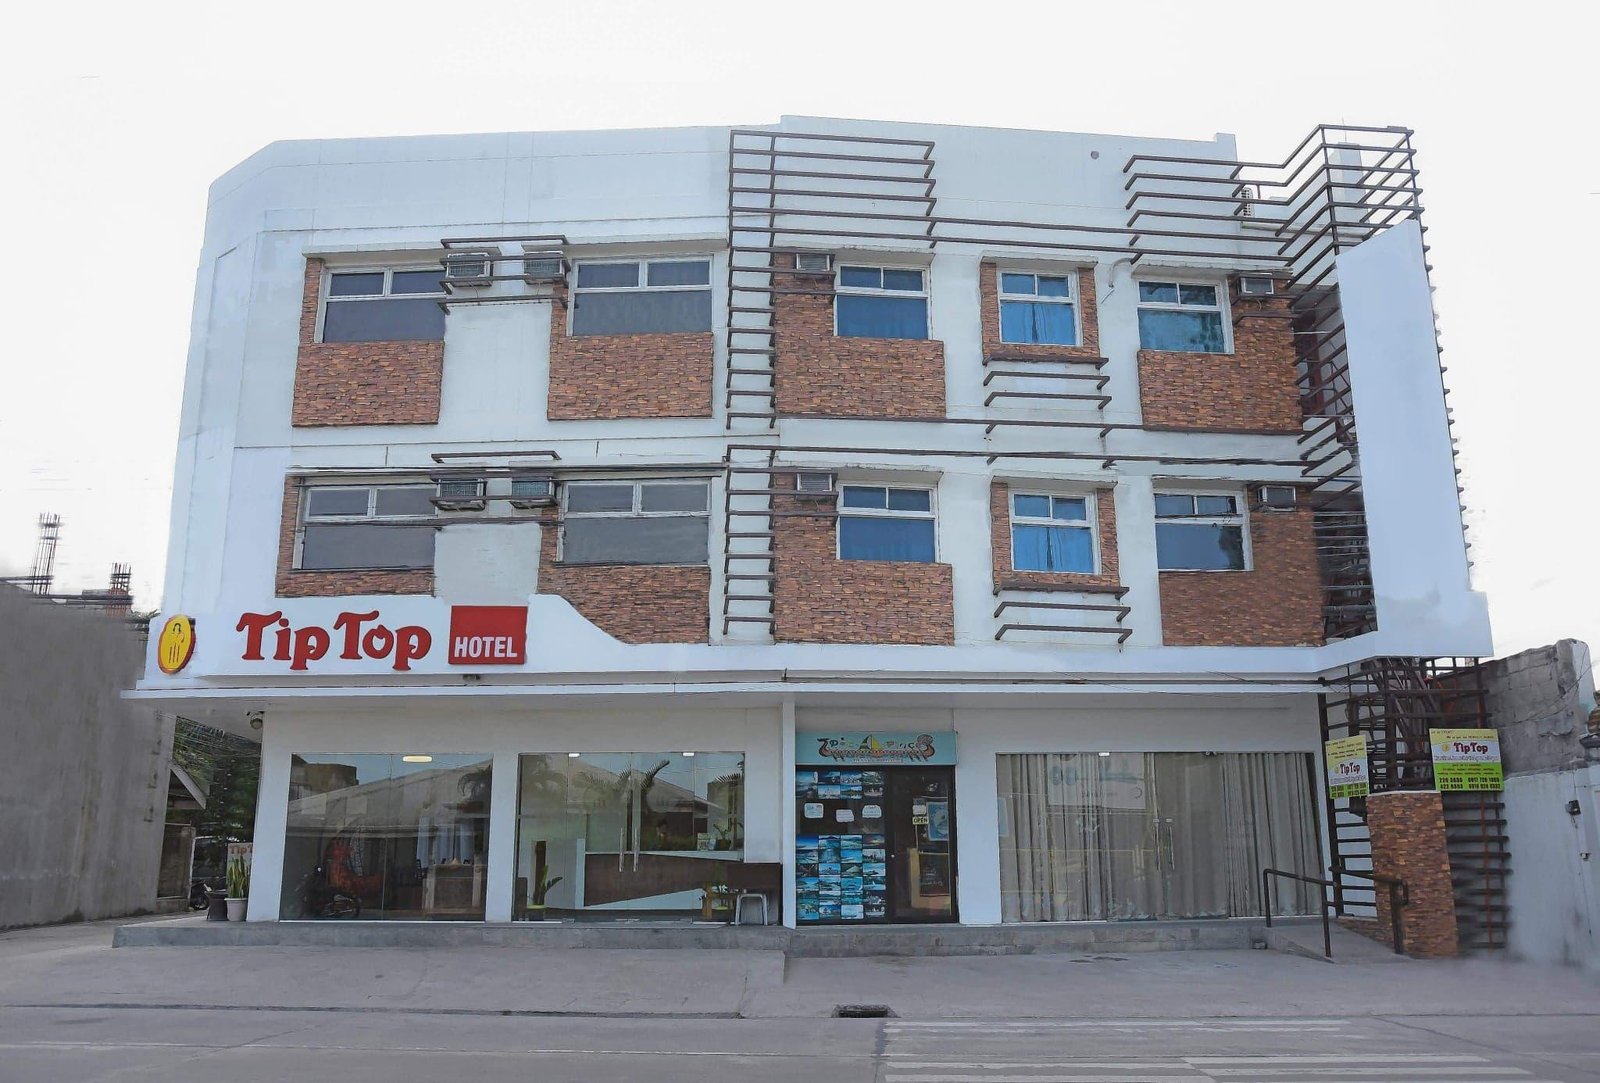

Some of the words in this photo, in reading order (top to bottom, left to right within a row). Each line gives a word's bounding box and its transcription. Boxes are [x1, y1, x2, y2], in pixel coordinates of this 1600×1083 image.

[236, 610, 330, 671] Tip
[333, 610, 432, 671] Top
[454, 636, 518, 659] HOTEL
